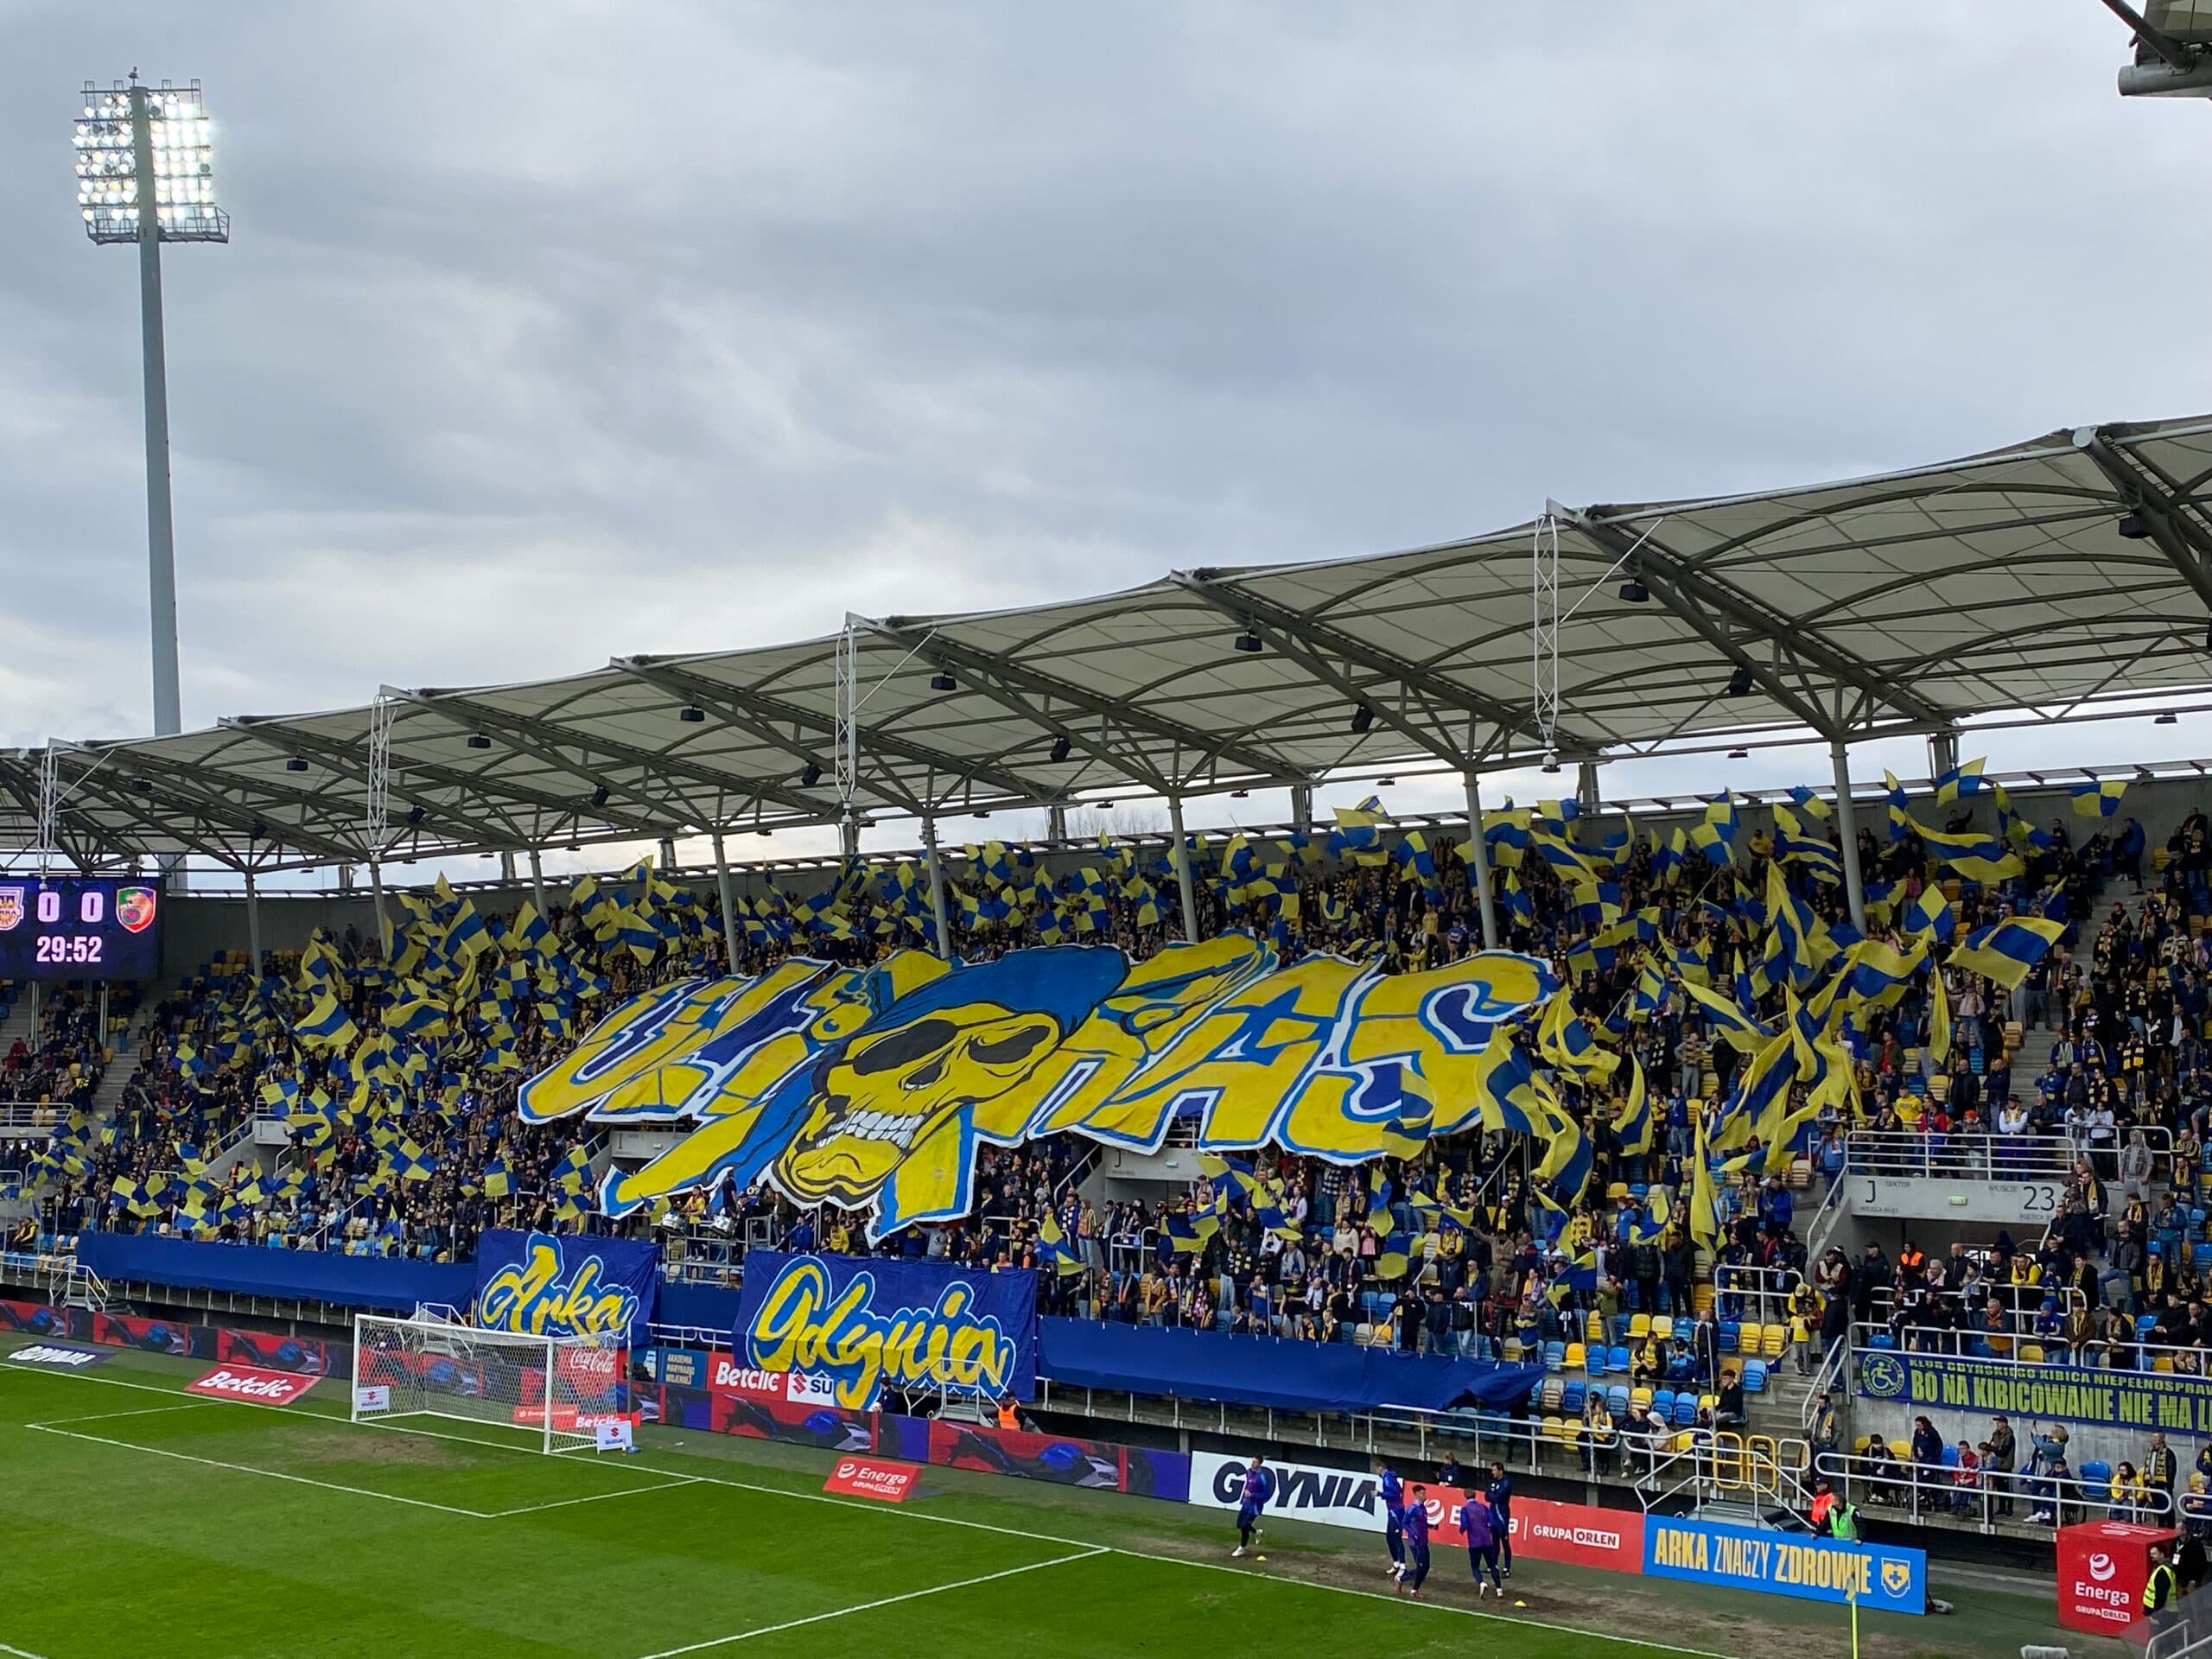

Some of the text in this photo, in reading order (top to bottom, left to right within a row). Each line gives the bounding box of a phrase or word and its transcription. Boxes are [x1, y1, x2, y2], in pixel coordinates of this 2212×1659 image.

[37, 892, 104, 922] 0 0
[36, 937, 102, 963] 29:52
[1866, 1180, 1876, 1203] J
[2024, 1186, 2055, 1211] 23
[479, 1232, 639, 1345] Arka
[747, 1256, 1014, 1408] Gdynia
[197, 1371, 294, 1397] Betclic
[715, 1361, 781, 1392] Betclic
[1909, 1359, 1943, 1370] KLUB
[2040, 1370, 2090, 1383] KIBICA
[1910, 1370, 1938, 1403] BO
[1943, 1374, 1970, 1407] NA
[1974, 1376, 2113, 1421] KIBICOWANIE
[2120, 1390, 2153, 1425] NIE
[2158, 1394, 2193, 1431] MA
[857, 1468, 908, 1485] Energa
[1533, 1524, 1618, 1548] GRUPA ORLEN
[1654, 1528, 1872, 1593] ARKA ZNACZY ZDROWIE
[2075, 1581, 2130, 1606] Energa
[2075, 1605, 2129, 1621] GRUPA ORLEN
